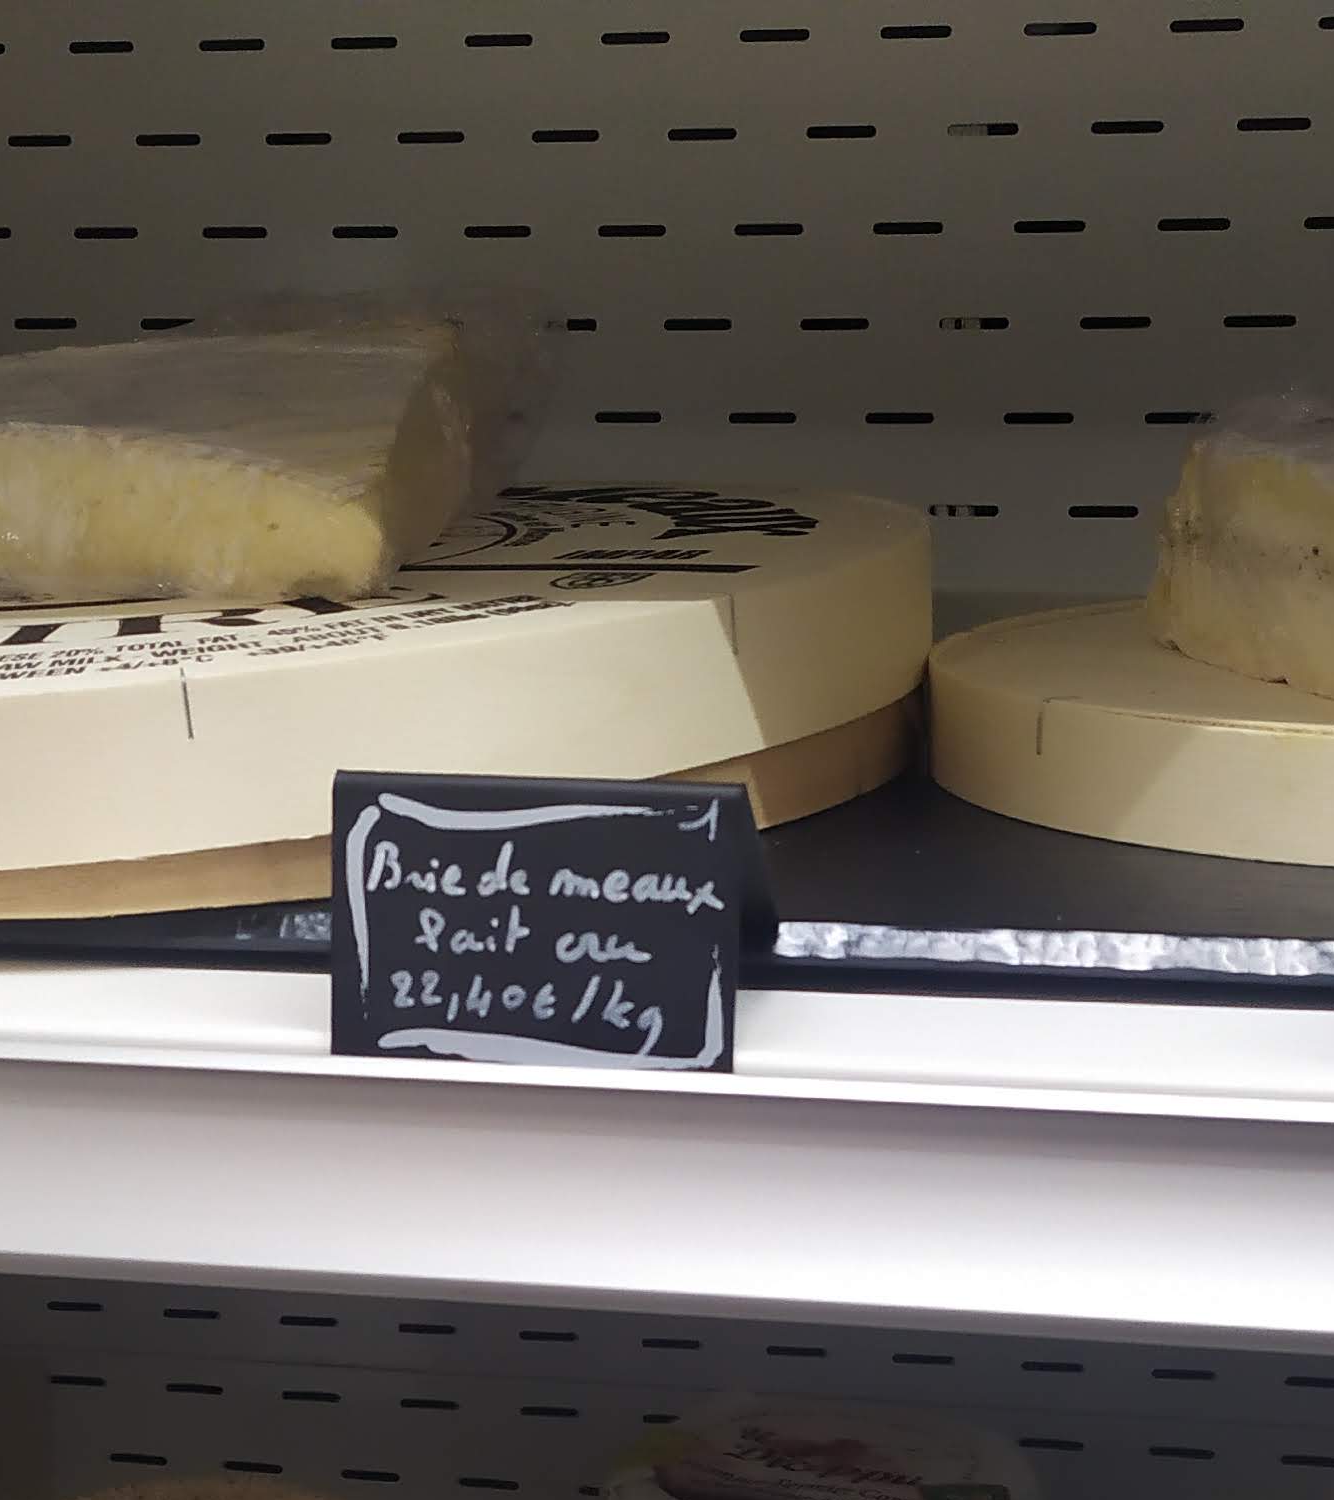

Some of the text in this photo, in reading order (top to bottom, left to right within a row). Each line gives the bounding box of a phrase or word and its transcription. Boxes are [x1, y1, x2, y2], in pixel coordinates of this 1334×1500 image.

[48, 655, 122, 668] MILK
[150, 641, 263, 659] WEIGHT
[291, 627, 383, 644] ABOUT
[115, 641, 184, 653] TOTAL
[198, 634, 239, 645] FAT
[324, 619, 368, 630] FAT
[367, 840, 466, 896] Brie
[476, 841, 530, 896] de
[415, 905, 530, 953] lait
